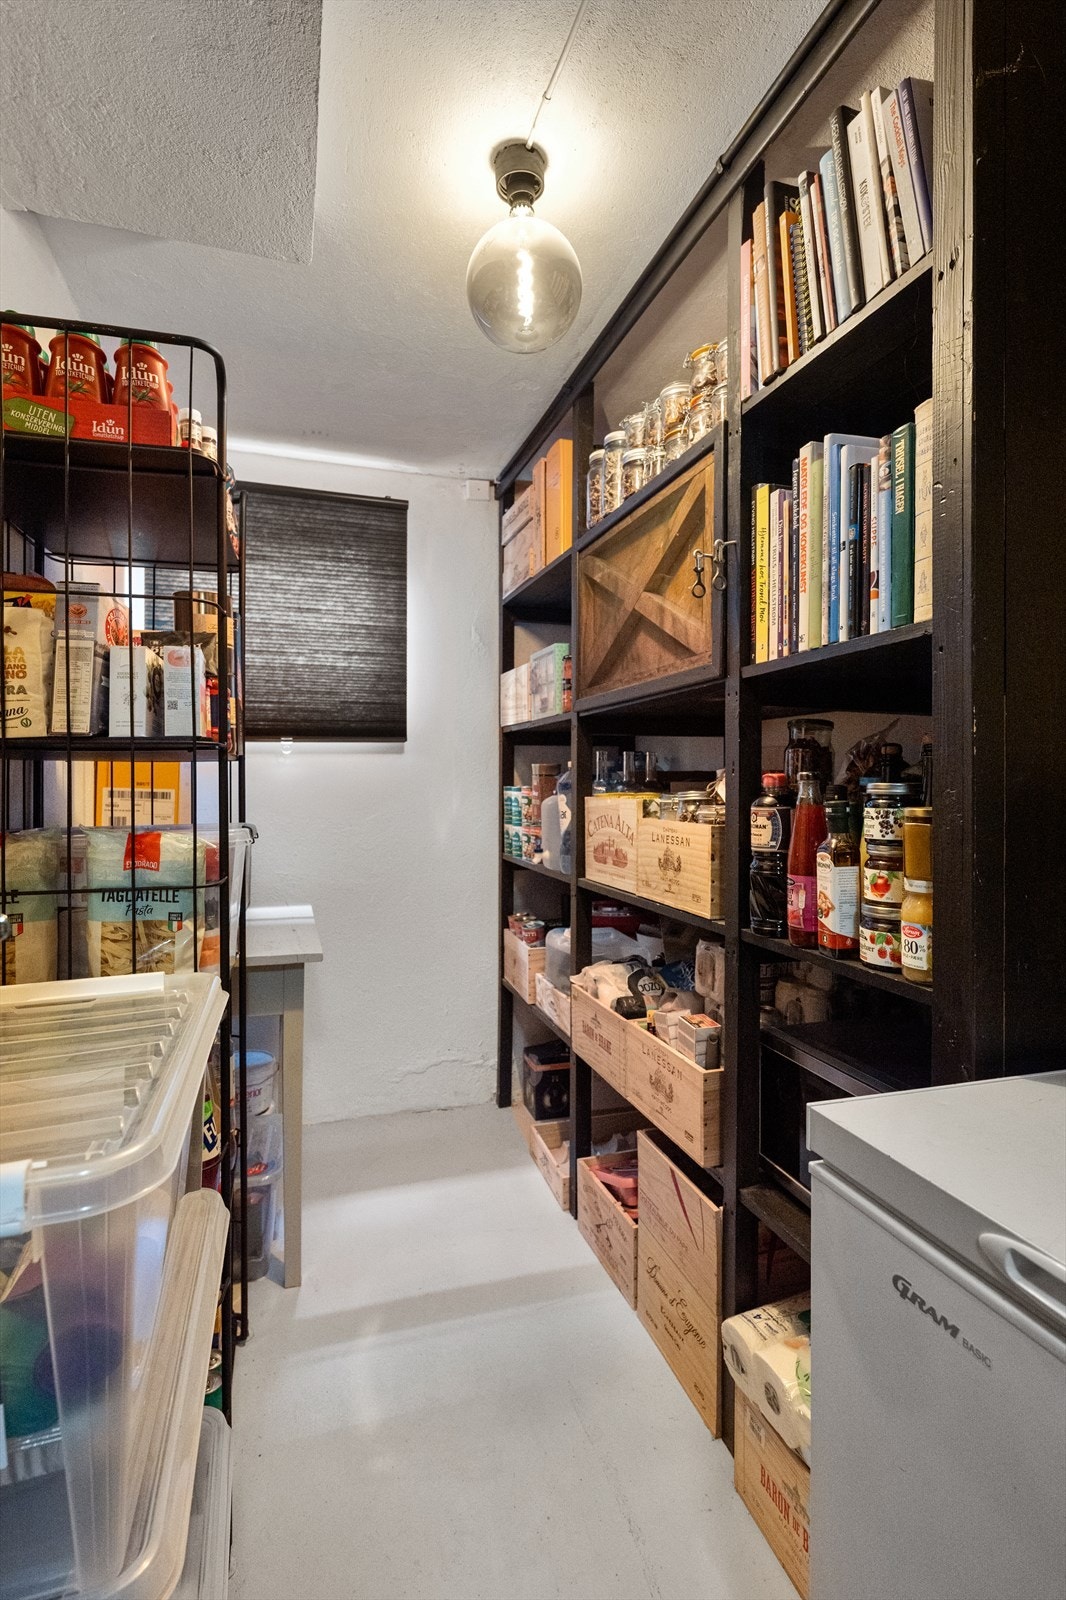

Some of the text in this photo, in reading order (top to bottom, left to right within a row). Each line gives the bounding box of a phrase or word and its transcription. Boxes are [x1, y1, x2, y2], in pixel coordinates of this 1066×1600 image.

[55, 355, 95, 376] Idun
[121, 366, 159, 384] Idun
[122, 380, 159, 389] TOATKETCHUP
[10, 409, 66, 434] KONSERVERINGS
[29, 405, 57, 422] UTEN
[24, 421, 50, 435] MIDDEL
[92, 420, 124, 435] Idun
[895, 439, 905, 479] TRIVSEL
[895, 484, 904, 515] HAGEN
[799, 456, 808, 594] MATGLEDE OG KOKEKUNST
[587, 813, 635, 847] CATENA ALTA
[651, 832, 691, 847] LANESSAN
[101, 889, 180, 903] TAGLATELLE
[125, 904, 154, 917] Pasta
[903, 938, 919, 955] 80
[891, 1273, 992, 1370] GRAM BASIC
[760, 1463, 791, 1521] BARON
[792, 1518, 801, 1538] DE
